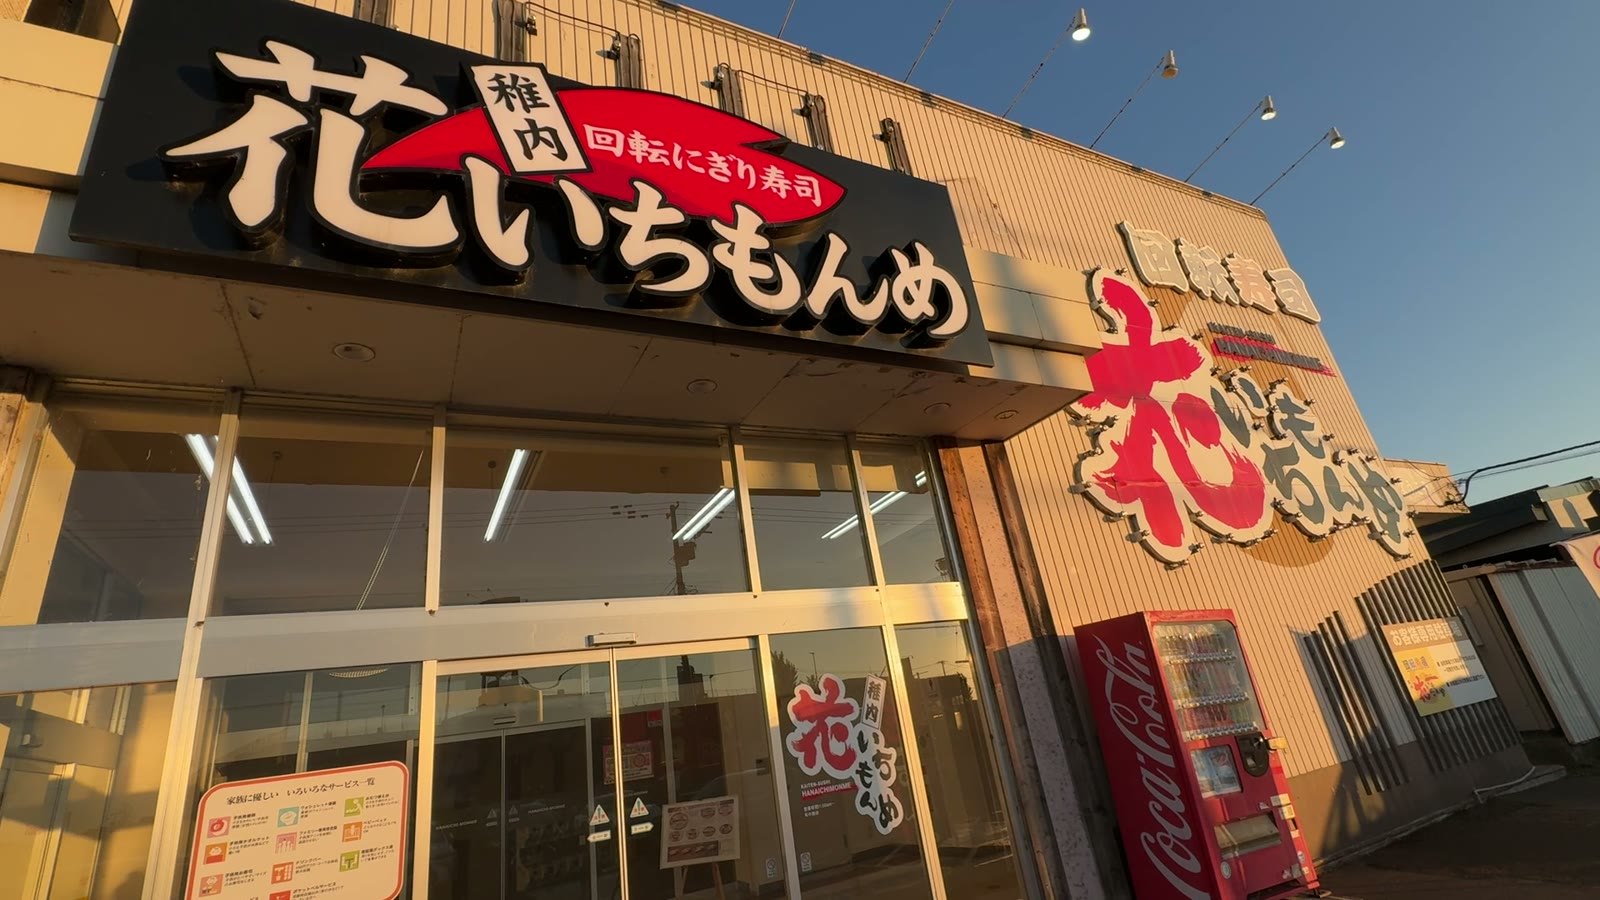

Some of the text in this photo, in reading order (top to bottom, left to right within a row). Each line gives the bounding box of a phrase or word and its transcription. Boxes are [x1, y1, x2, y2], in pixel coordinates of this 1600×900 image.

[487, 73, 569, 162] 稚内
[165, 41, 969, 338] 花いちもんめ
[585, 123, 822, 207] 回転にぎり寿司
[1122, 223, 1320, 322] 回転寿司
[226, 778, 375, 805] 家族に優しい いろいろなサービス一覧
[802, 782, 852, 797] HANAICHIMONME
[1093, 634, 1210, 900] Coca-Cola
